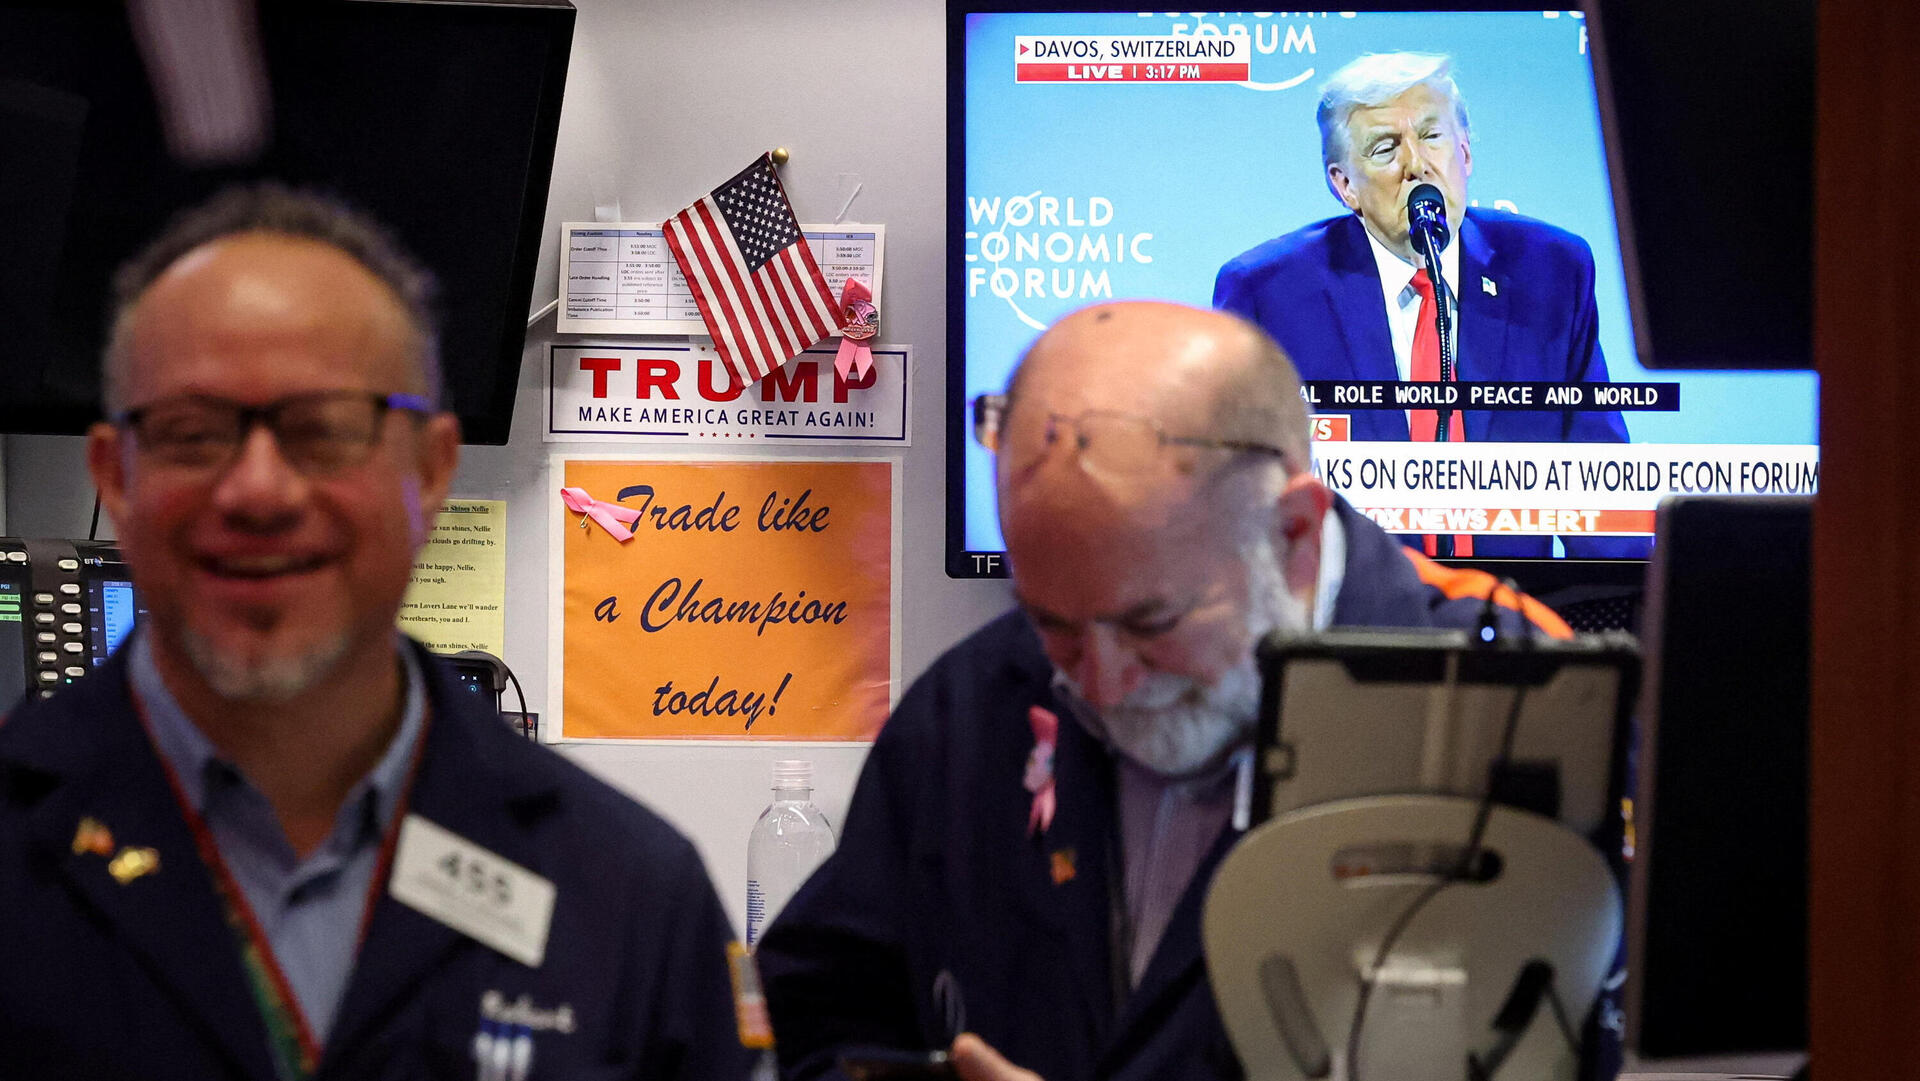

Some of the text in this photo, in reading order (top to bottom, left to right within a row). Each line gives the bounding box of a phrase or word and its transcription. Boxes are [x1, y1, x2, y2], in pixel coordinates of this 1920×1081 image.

[1034, 40, 1235, 61] DAVOS, SWITZERLAND
[1067, 64, 1201, 79] LIVE 3:17 PM
[968, 196, 1114, 227] WORLD
[965, 231, 1154, 264] CONOMIC
[969, 267, 1113, 299] FORUM
[580, 357, 877, 403] TRUMP
[1300, 386, 1658, 405] AL ROLE WORLD PEACE AND WORLD
[579, 406, 874, 427] MAKE AMERICA GREAT AGAIN!
[1312, 458, 1819, 494] AKS ON GREENLAND AT WORLD ECON FORUM
[616, 484, 830, 533] Trade like
[1365, 508, 1601, 532] OX NEWS ALERT
[971, 555, 1001, 574] TF
[594, 577, 847, 637] a Champion
[653, 672, 793, 731] today!
